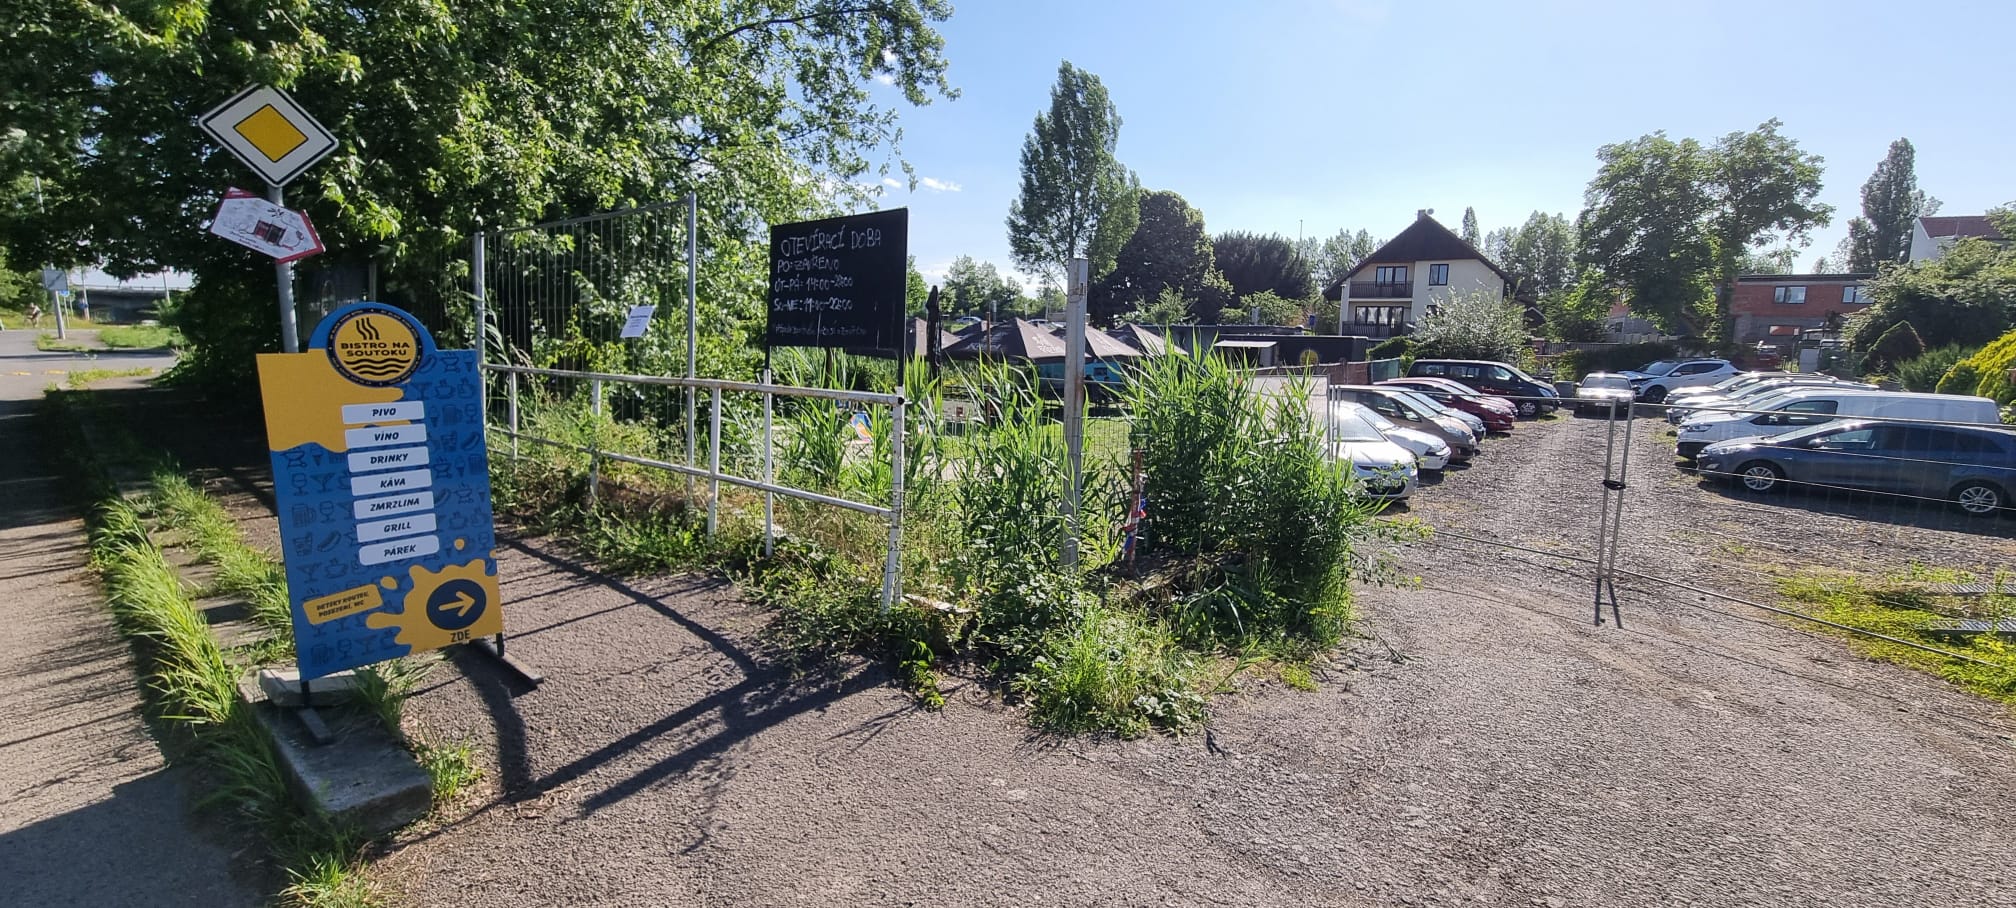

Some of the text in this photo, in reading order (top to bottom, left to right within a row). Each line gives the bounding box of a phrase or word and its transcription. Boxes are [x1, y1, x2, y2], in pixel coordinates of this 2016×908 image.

[781, 224, 881, 257] OTEVÍRACÍ DOBA
[340, 342, 387, 350] BISTRO
[346, 349, 407, 357] SOUTOKU
[372, 408, 397, 417] PIVO
[374, 431, 400, 441] VÍNO
[370, 453, 409, 465] DRINKY
[380, 476, 406, 489] KÁVA
[370, 497, 420, 512] ZMRZLINA
[383, 521, 412, 533] GRILL
[383, 542, 418, 558] PÁREK
[450, 629, 471, 643] ZDE
